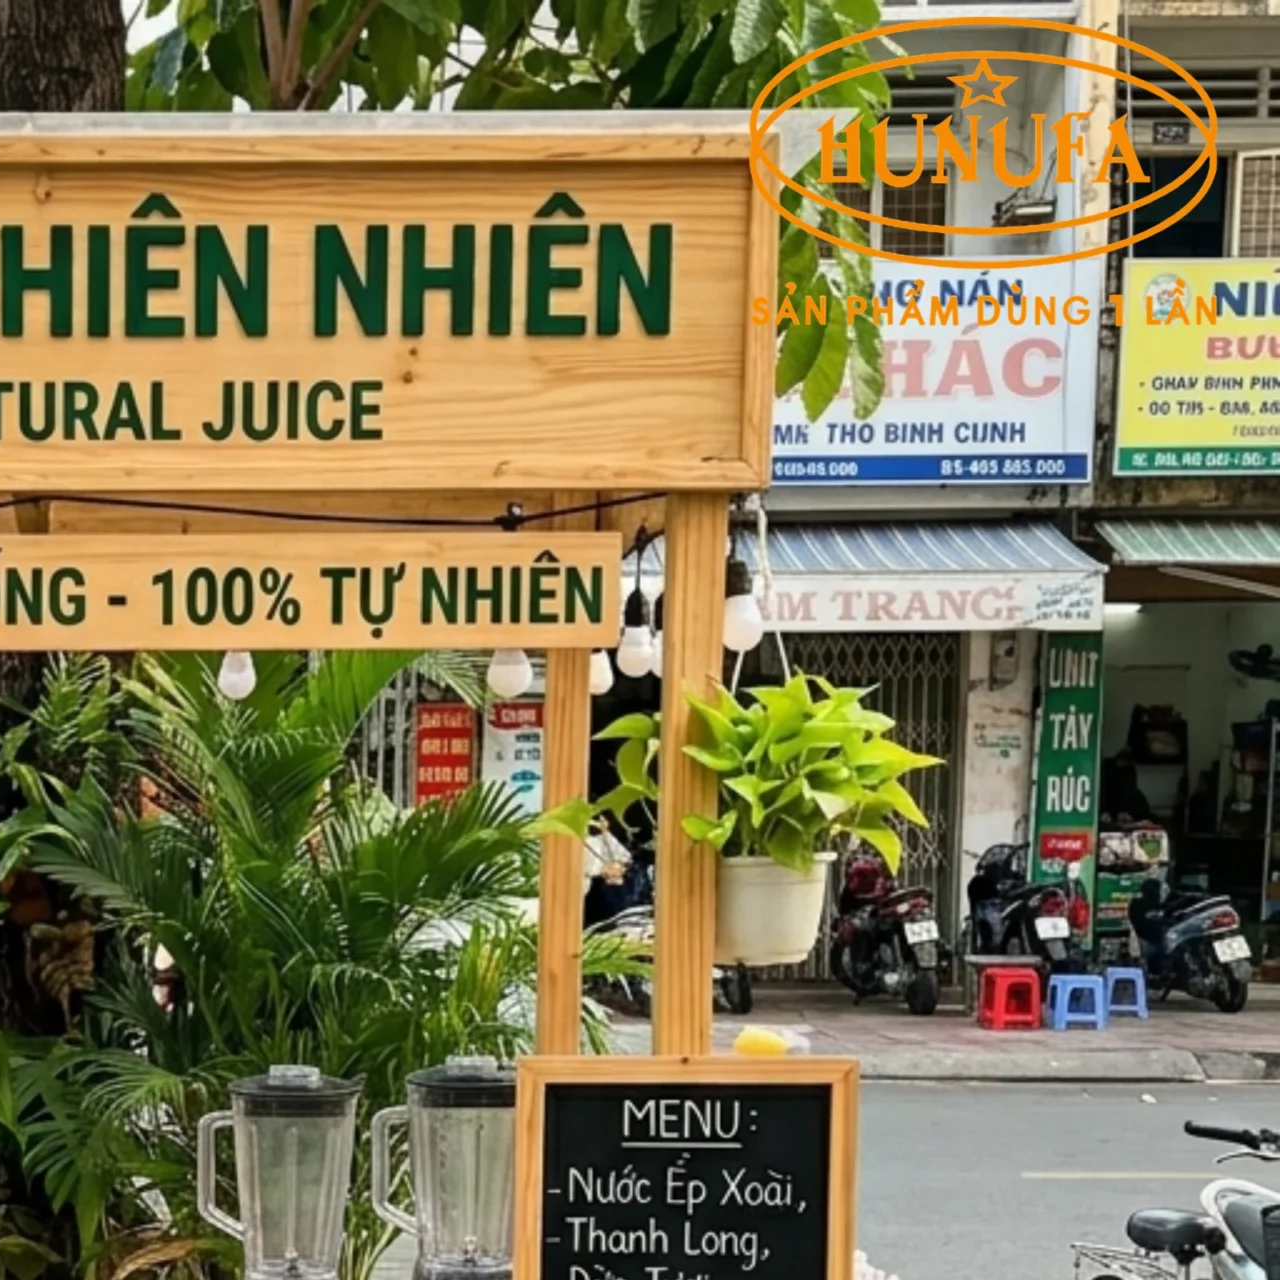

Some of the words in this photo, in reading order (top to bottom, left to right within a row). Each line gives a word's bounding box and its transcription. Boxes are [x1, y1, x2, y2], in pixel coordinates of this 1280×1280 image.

[313, 192, 673, 337] NHIÊN
[1214, 268, 1280, 317] NI
[201, 381, 384, 441] JUICE
[884, 422, 944, 444] BINH
[107, 593, 128, 607] -
[151, 566, 301, 627] 100%
[320, 562, 405, 639] TỰ
[420, 549, 604, 625] NHIÊN
[565, 1217, 669, 1254] Thanh
[684, 1221, 770, 1272] Long,
